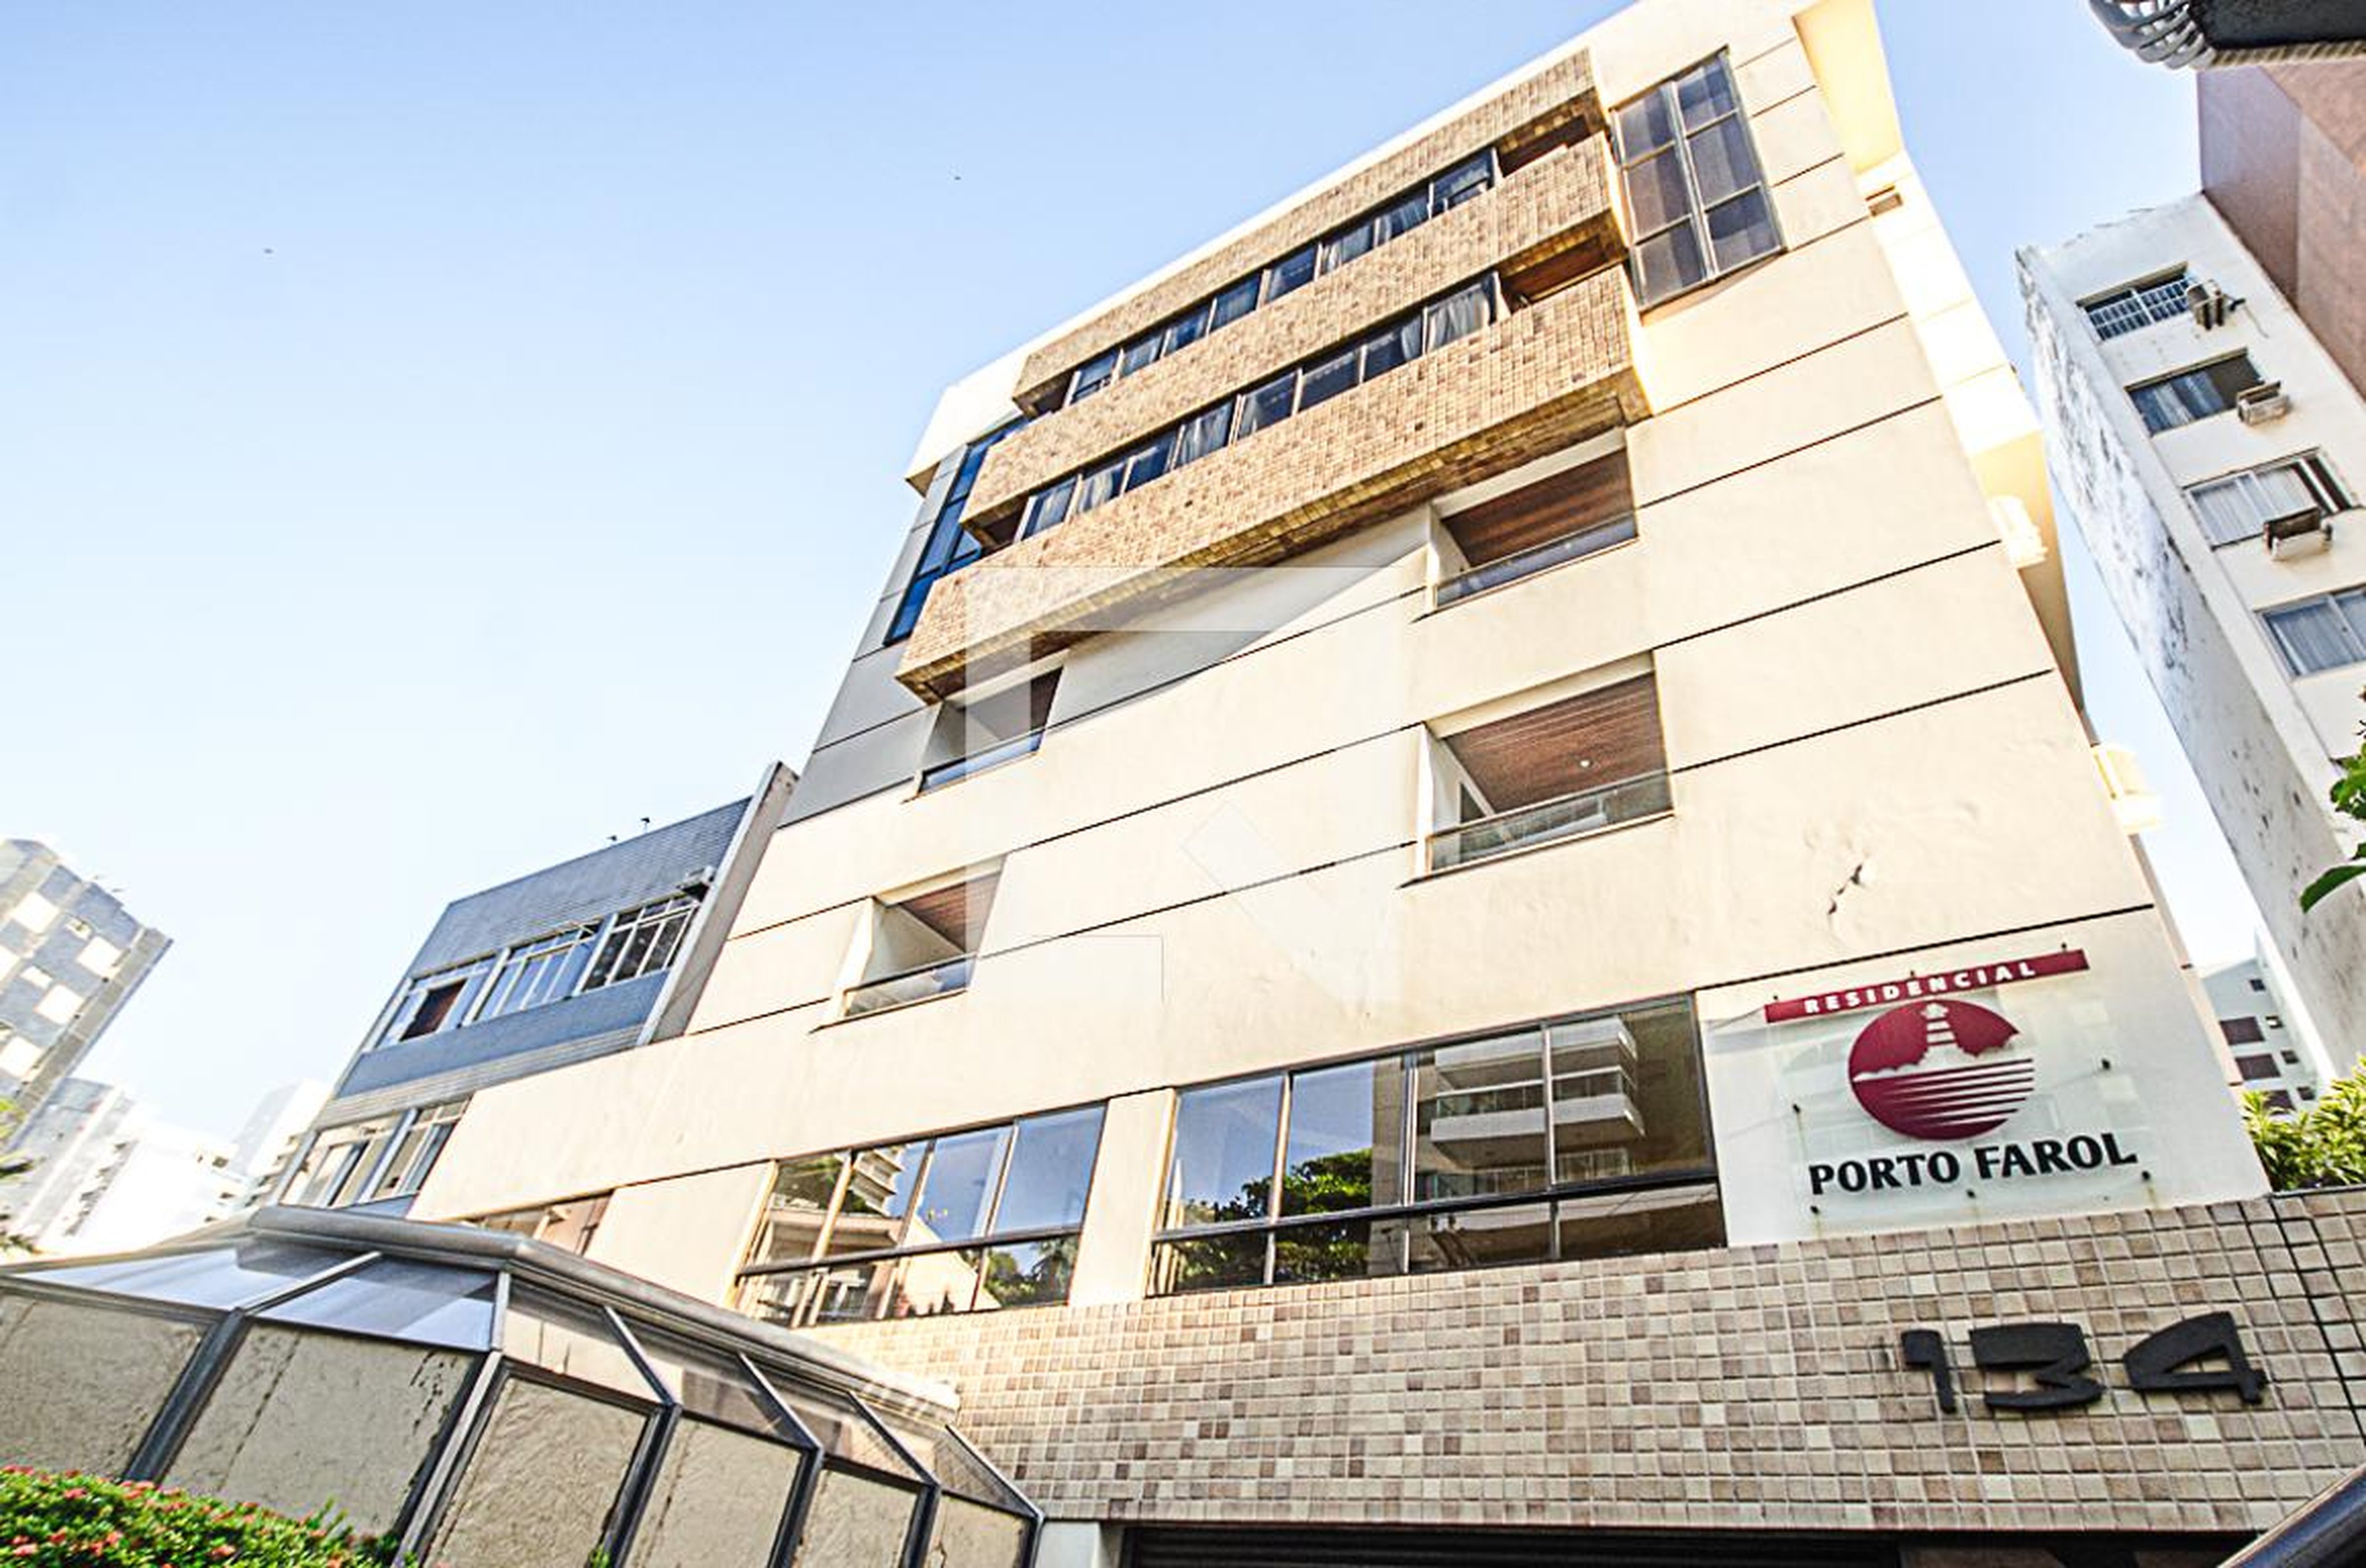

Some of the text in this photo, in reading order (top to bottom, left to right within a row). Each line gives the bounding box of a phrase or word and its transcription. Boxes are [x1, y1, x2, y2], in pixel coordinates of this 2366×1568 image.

[1803, 962, 2037, 1014] RESIDENCIAL
[1809, 1131, 2138, 1195] PORTO FAROL
[1901, 1310, 2269, 1414] 134
